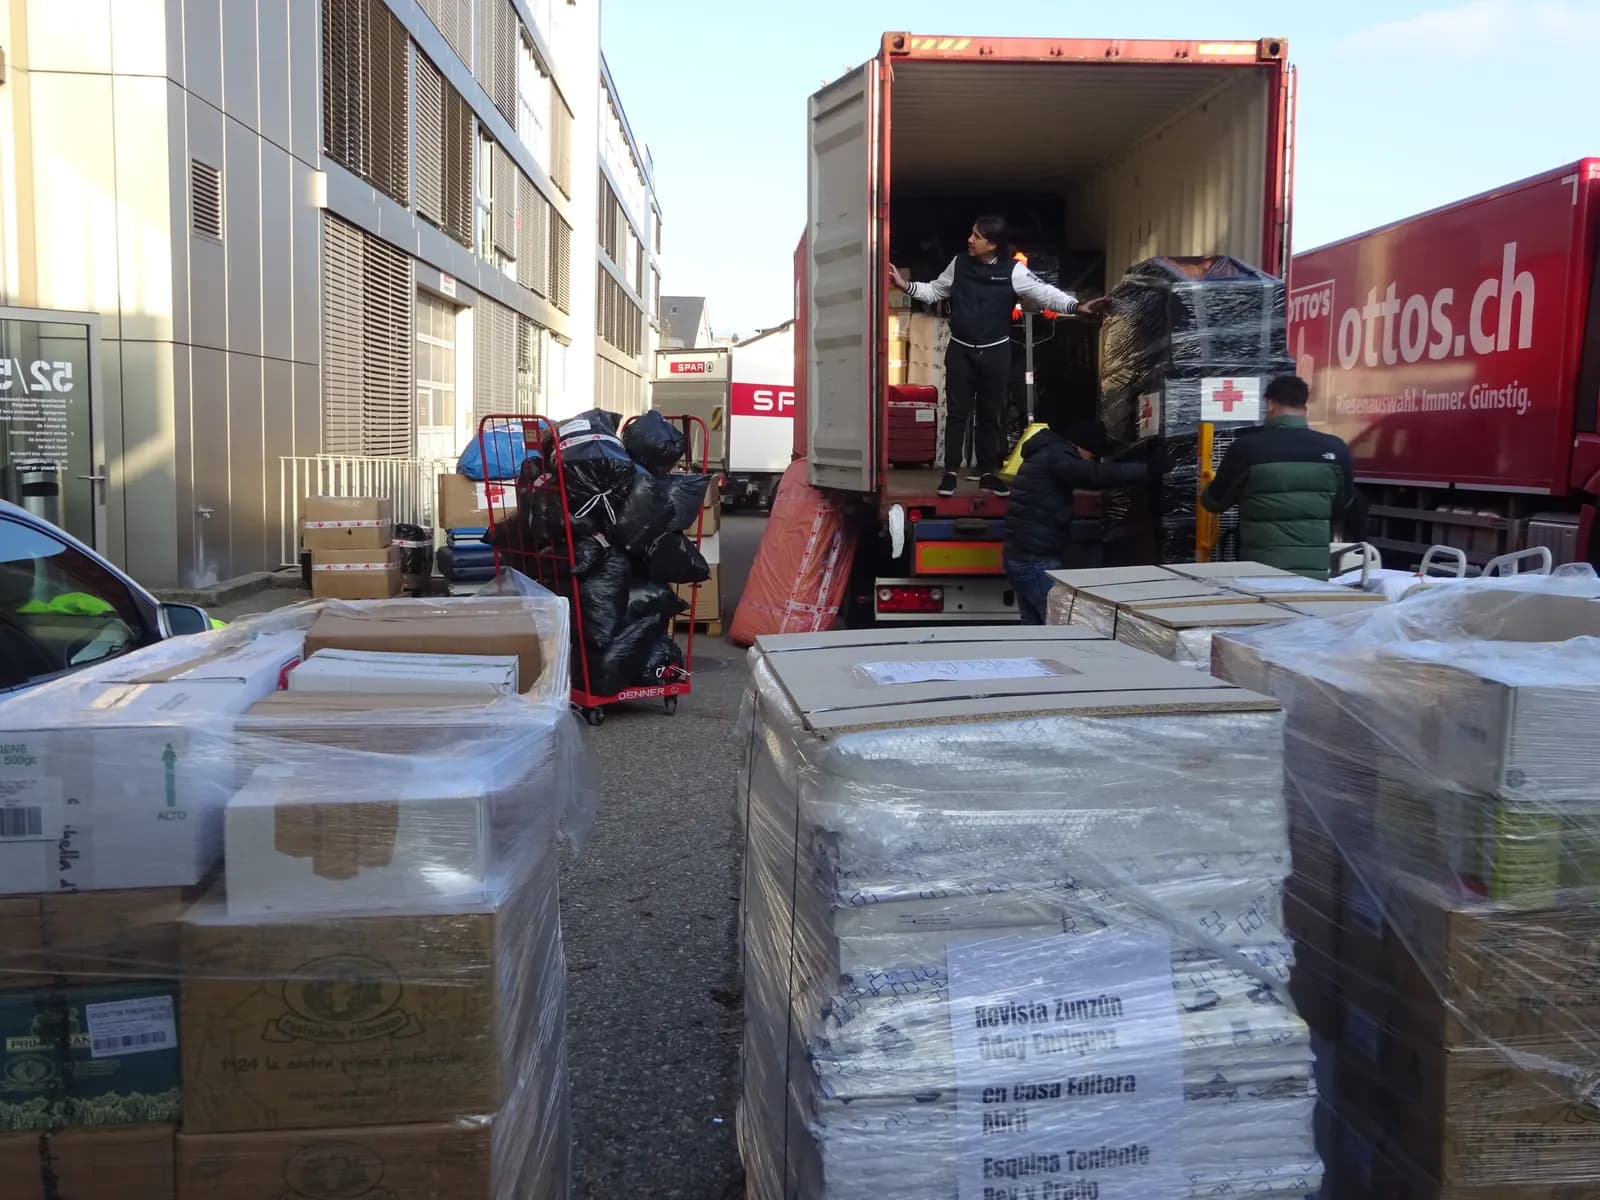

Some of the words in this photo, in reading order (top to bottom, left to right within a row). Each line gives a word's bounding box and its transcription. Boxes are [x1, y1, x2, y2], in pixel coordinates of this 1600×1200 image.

[1338, 241, 1536, 370] ottos.ch
[677, 363, 704, 372] SPAR
[1421, 388, 1467, 412] Immer.
[1469, 380, 1532, 416] Günstig.
[618, 687, 665, 701] DENNER
[157, 811, 187, 821] ALTO
[975, 1000, 1049, 1029] Revista
[1053, 994, 1124, 1023] Zunzún
[978, 1034, 1027, 1061] Oday
[982, 1085, 1008, 1104] en
[1013, 1081, 1062, 1101] Casa
[1066, 1074, 1137, 1097] Editora
[982, 1108, 1028, 1136] Abril
[983, 1152, 1061, 1181] Esquina
[1065, 1144, 1150, 1172] Teniente
